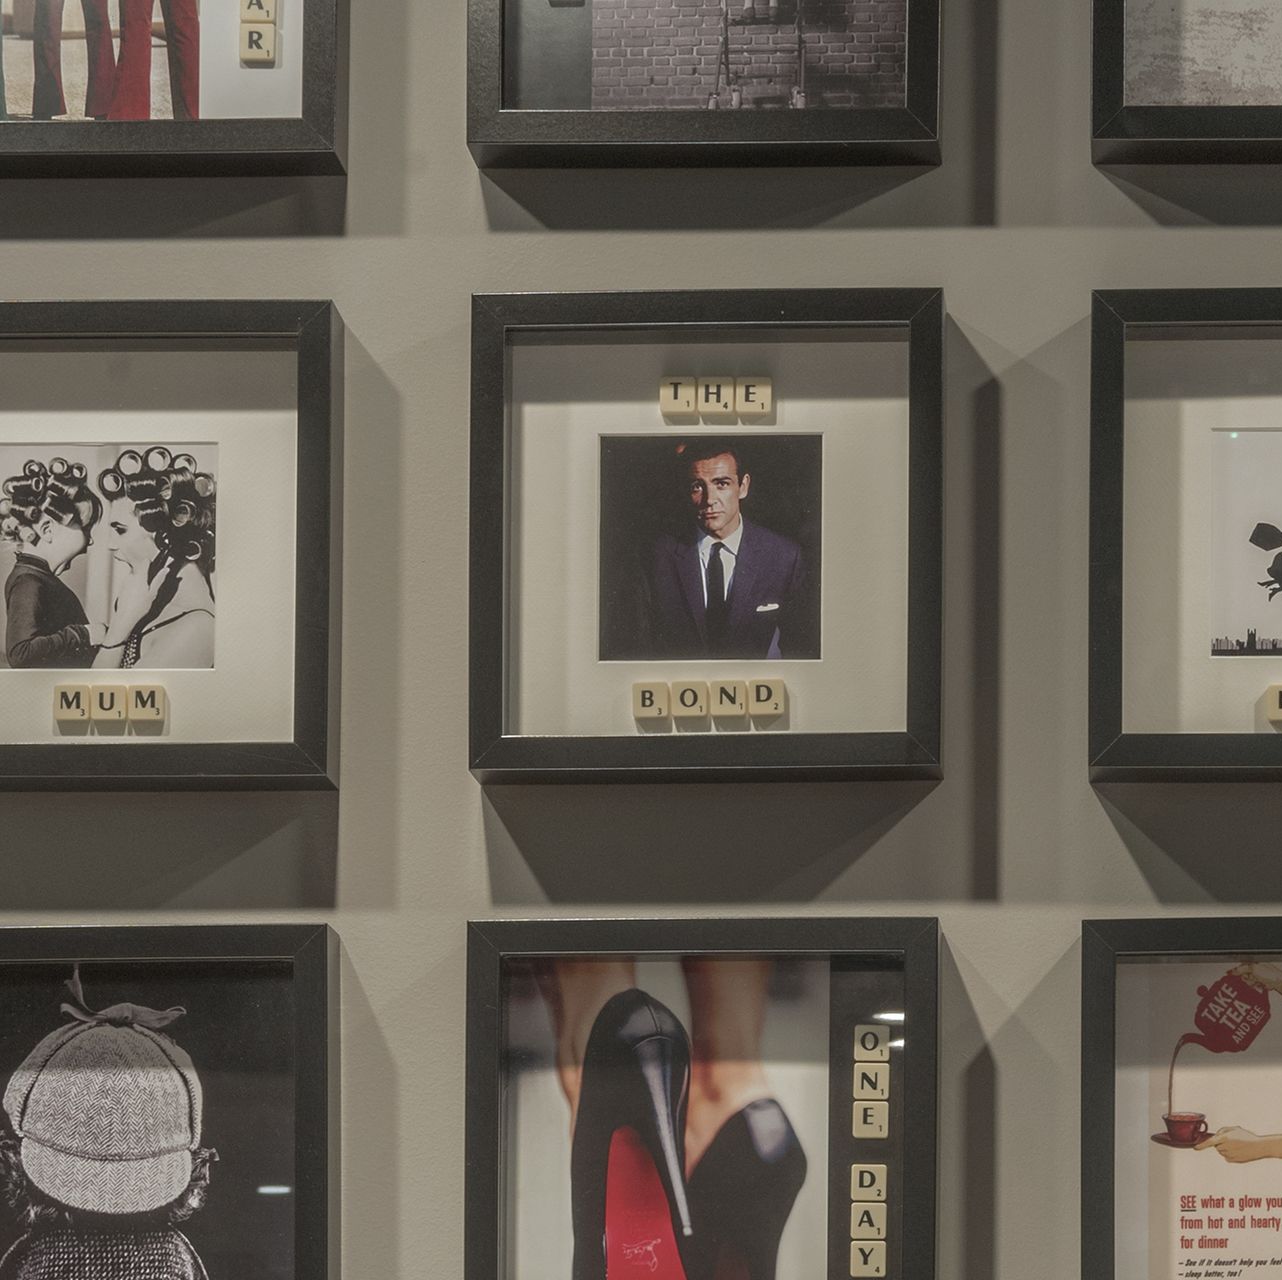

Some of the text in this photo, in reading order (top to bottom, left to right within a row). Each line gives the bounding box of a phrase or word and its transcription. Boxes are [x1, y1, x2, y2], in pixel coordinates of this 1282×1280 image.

[668, 382, 765, 409] THE
[60, 690, 160, 716] MUM
[640, 684, 779, 714] BOND
[1201, 983, 1238, 1023] TAKE
[1219, 1000, 1252, 1030] TEA
[1231, 1004, 1265, 1044] AND SEE
[859, 1031, 884, 1132] ONE
[1180, 1195, 1197, 1209] SEE
[1201, 1195, 1225, 1208] what
[1229, 1198, 1234, 1208] a
[1238, 1195, 1262, 1212] glow
[1266, 1197, 1282, 1211] you
[857, 1169, 882, 1274] DAY
[1180, 1216, 1203, 1229] from
[1208, 1216, 1224, 1229] hot
[1228, 1216, 1246, 1229] and
[1250, 1216, 1281, 1232] hearty
[1180, 1235, 1229, 1249] for dinner
[1185, 1270, 1202, 1279] sleep
[1239, 1258, 1253, 1267] help
[1256, 1260, 1267, 1268] you
[1270, 1258, 1282, 1266] feel
